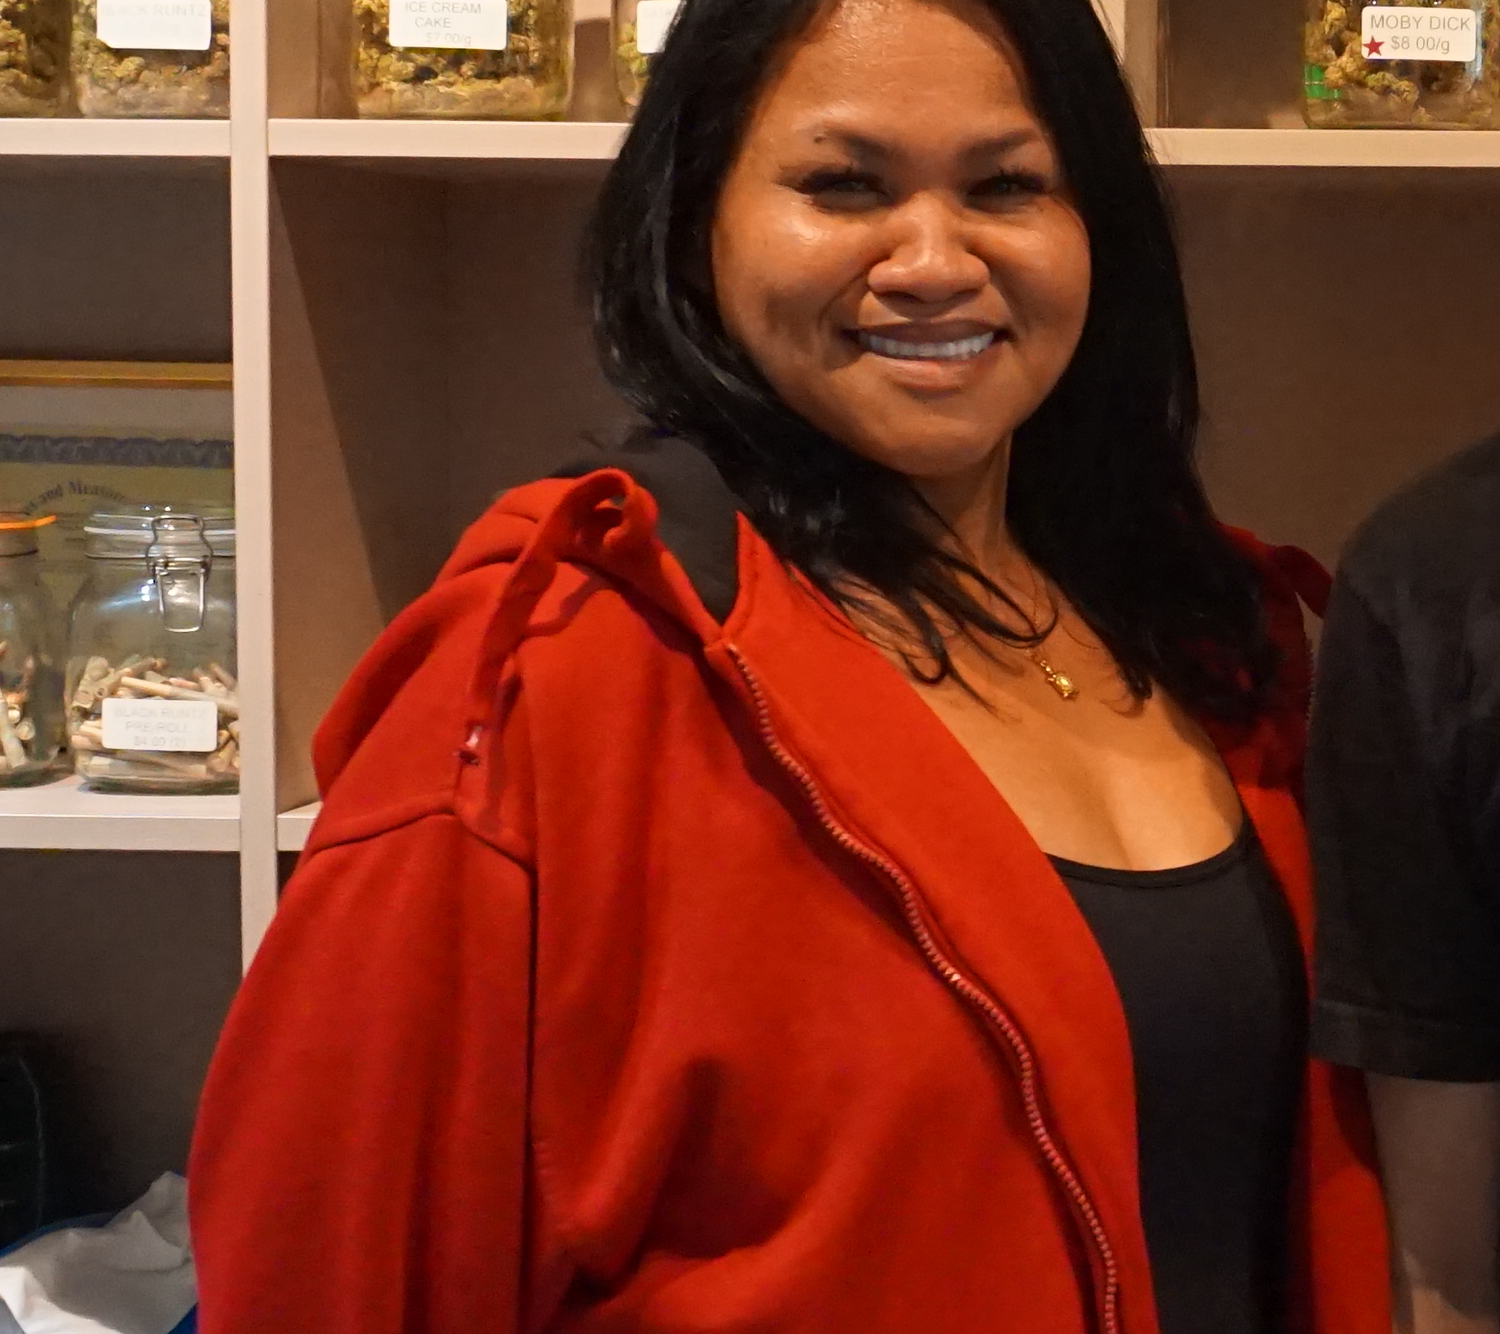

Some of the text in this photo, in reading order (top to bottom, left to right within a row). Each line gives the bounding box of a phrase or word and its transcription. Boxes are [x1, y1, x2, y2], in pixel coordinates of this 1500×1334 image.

[153, 3, 206, 18] RUNTZ
[404, 0, 483, 15] ICE CREAM
[414, 16, 452, 29] CAKE
[1370, 14, 1471, 31] MOBY DICK
[425, 31, 473, 46] $700/g
[1390, 35, 1451, 55] $800/g
[125, 721, 192, 733] PRE-ROLL
[133, 735, 167, 747] $400
